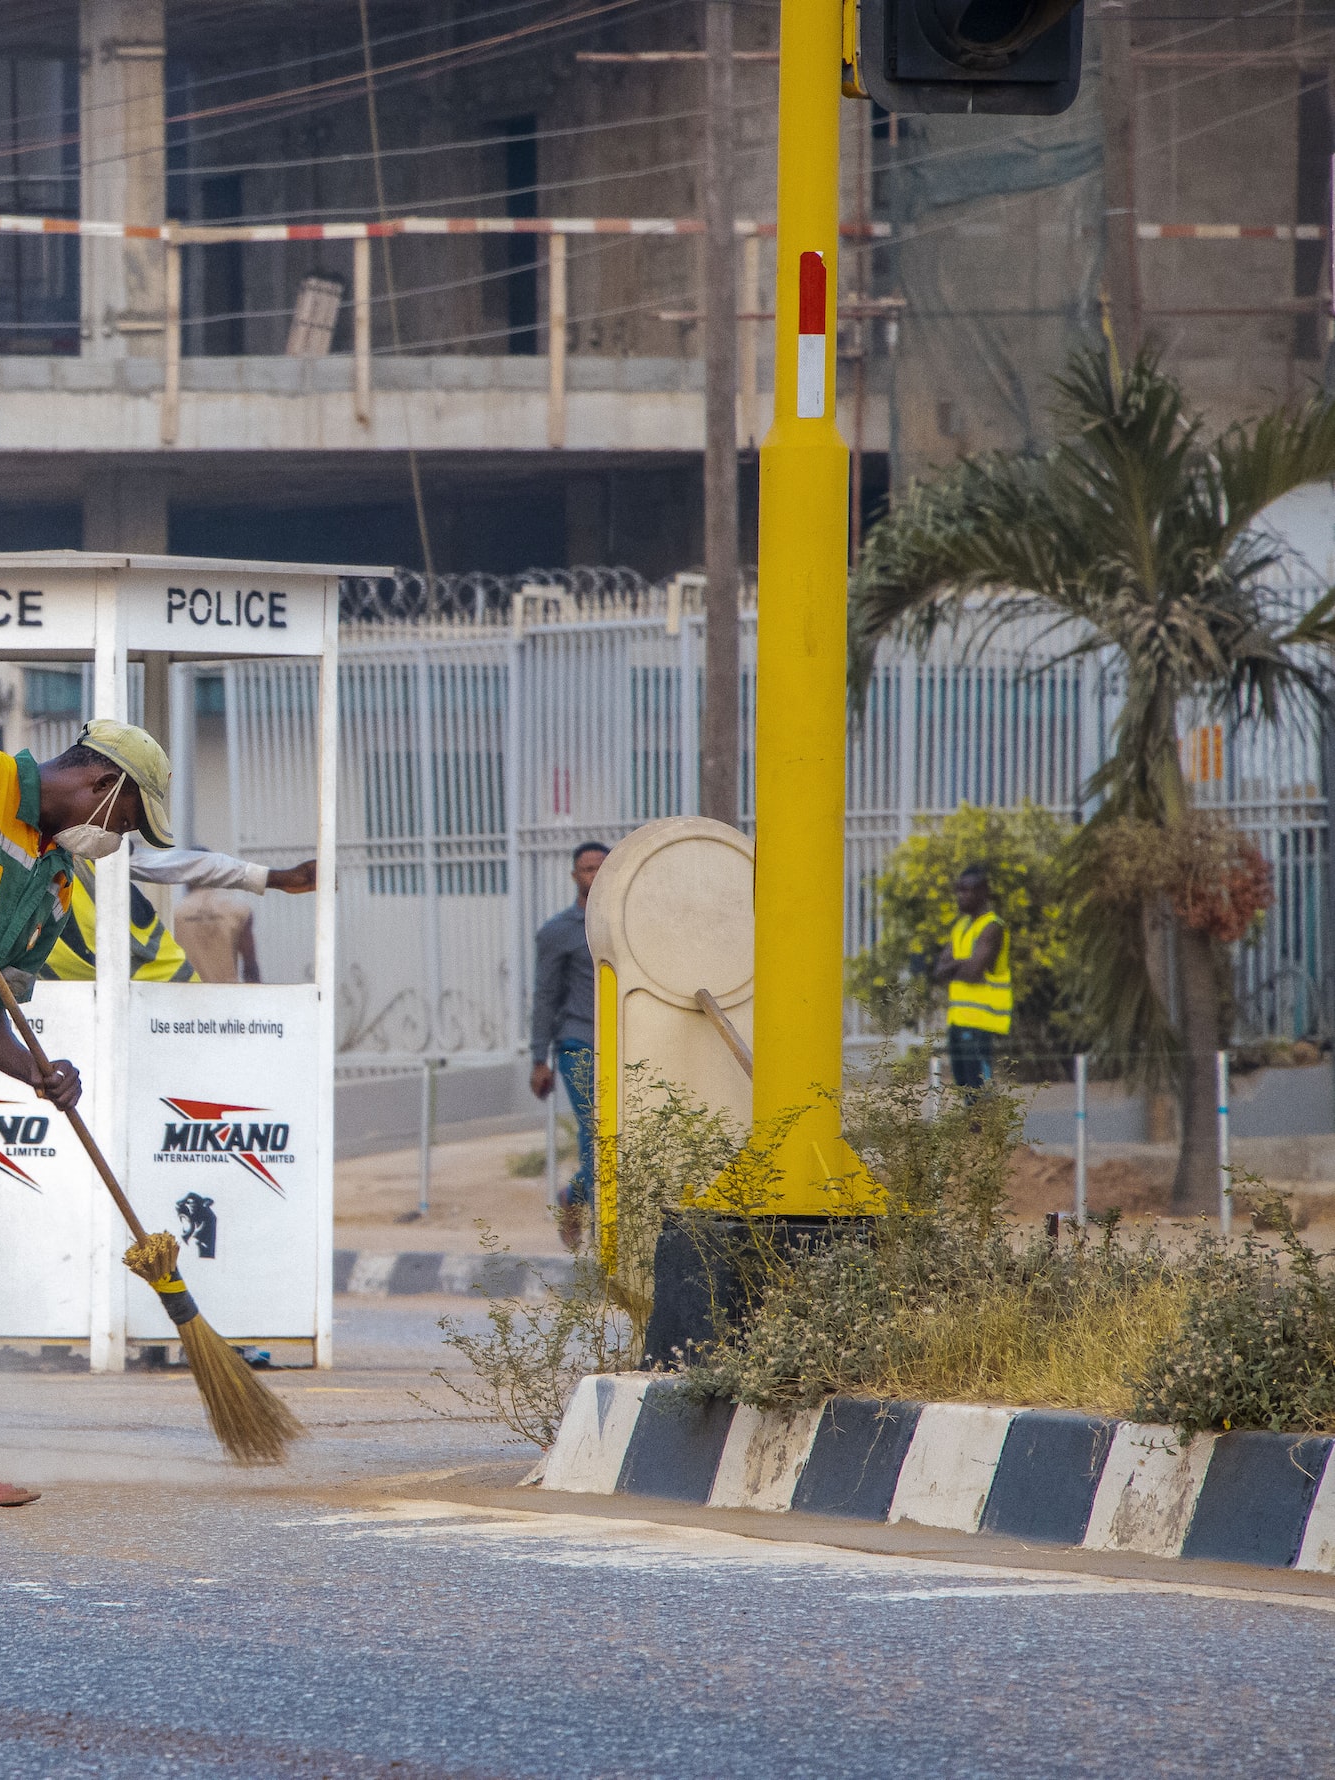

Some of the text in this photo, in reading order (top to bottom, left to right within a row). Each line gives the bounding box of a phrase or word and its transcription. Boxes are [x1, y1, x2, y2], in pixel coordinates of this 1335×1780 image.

[167, 588, 287, 628] POLICE
[150, 1018, 284, 1039] Use seat belt while driving
[161, 1123, 290, 1152] MIKANO
[6, 1147, 57, 1157] LIMITED
[153, 1153, 295, 1164] INTERNATIONAL LIMITED
